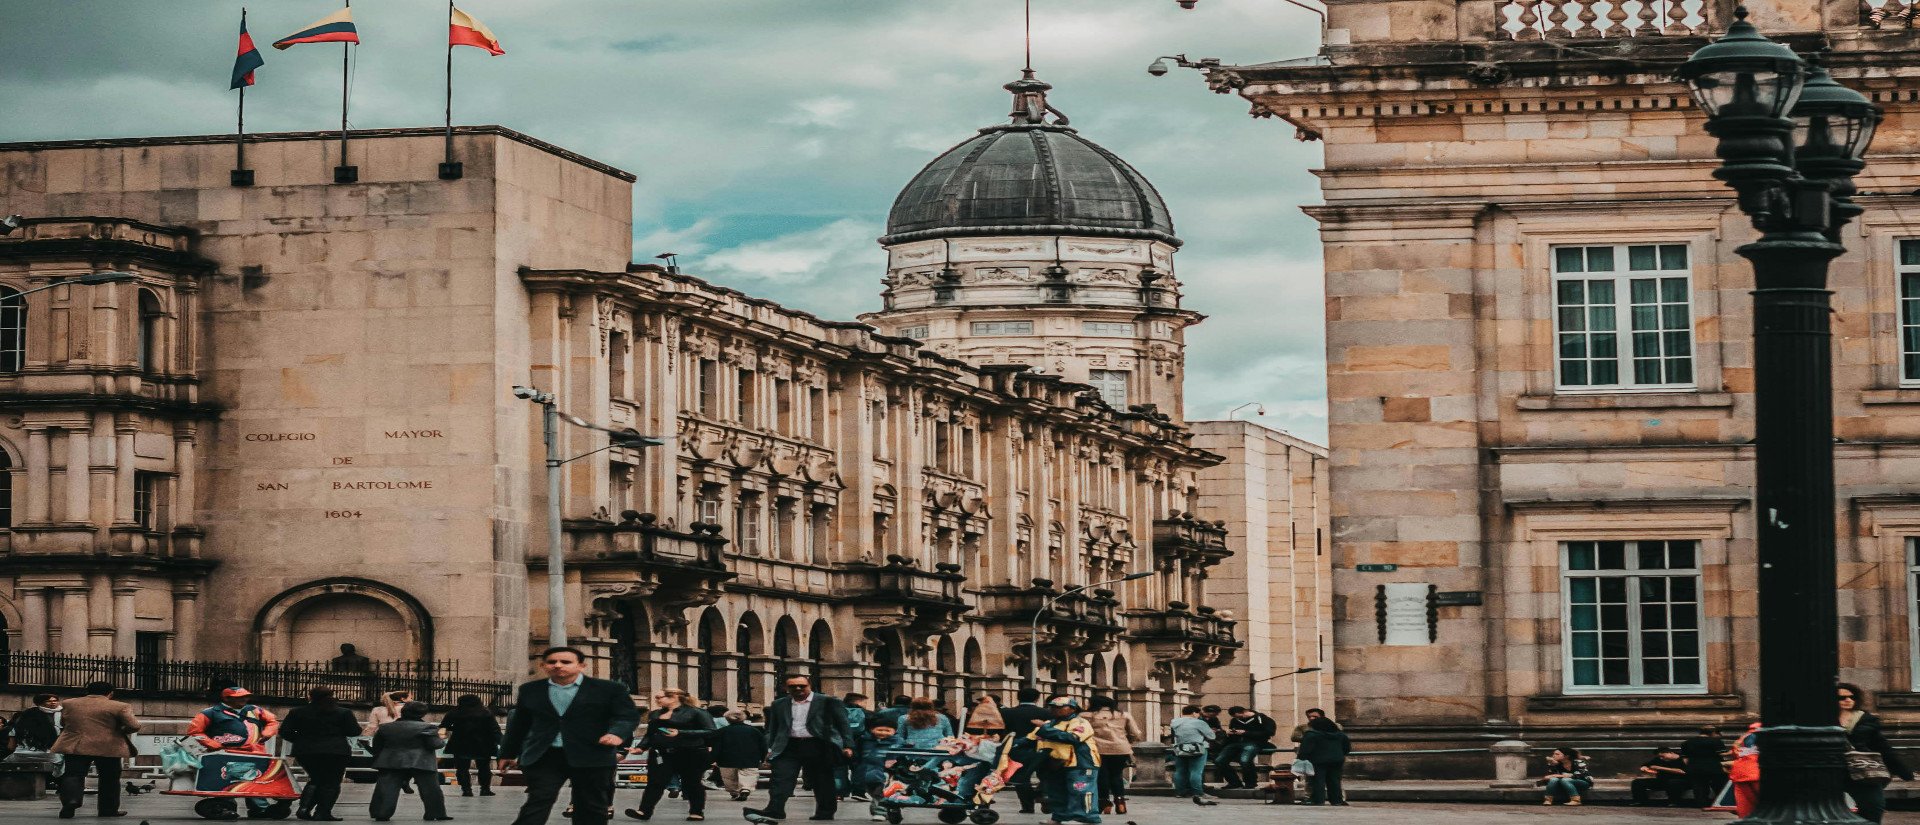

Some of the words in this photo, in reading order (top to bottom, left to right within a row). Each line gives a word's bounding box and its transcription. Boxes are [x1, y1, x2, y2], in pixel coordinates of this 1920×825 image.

[245, 432, 316, 442] COLEGIO
[384, 429, 444, 440] MAYOR
[332, 456, 354, 465] DE
[256, 482, 289, 491] SAN
[332, 480, 433, 490] BARTOLOME
[324, 510, 363, 519] 1604
